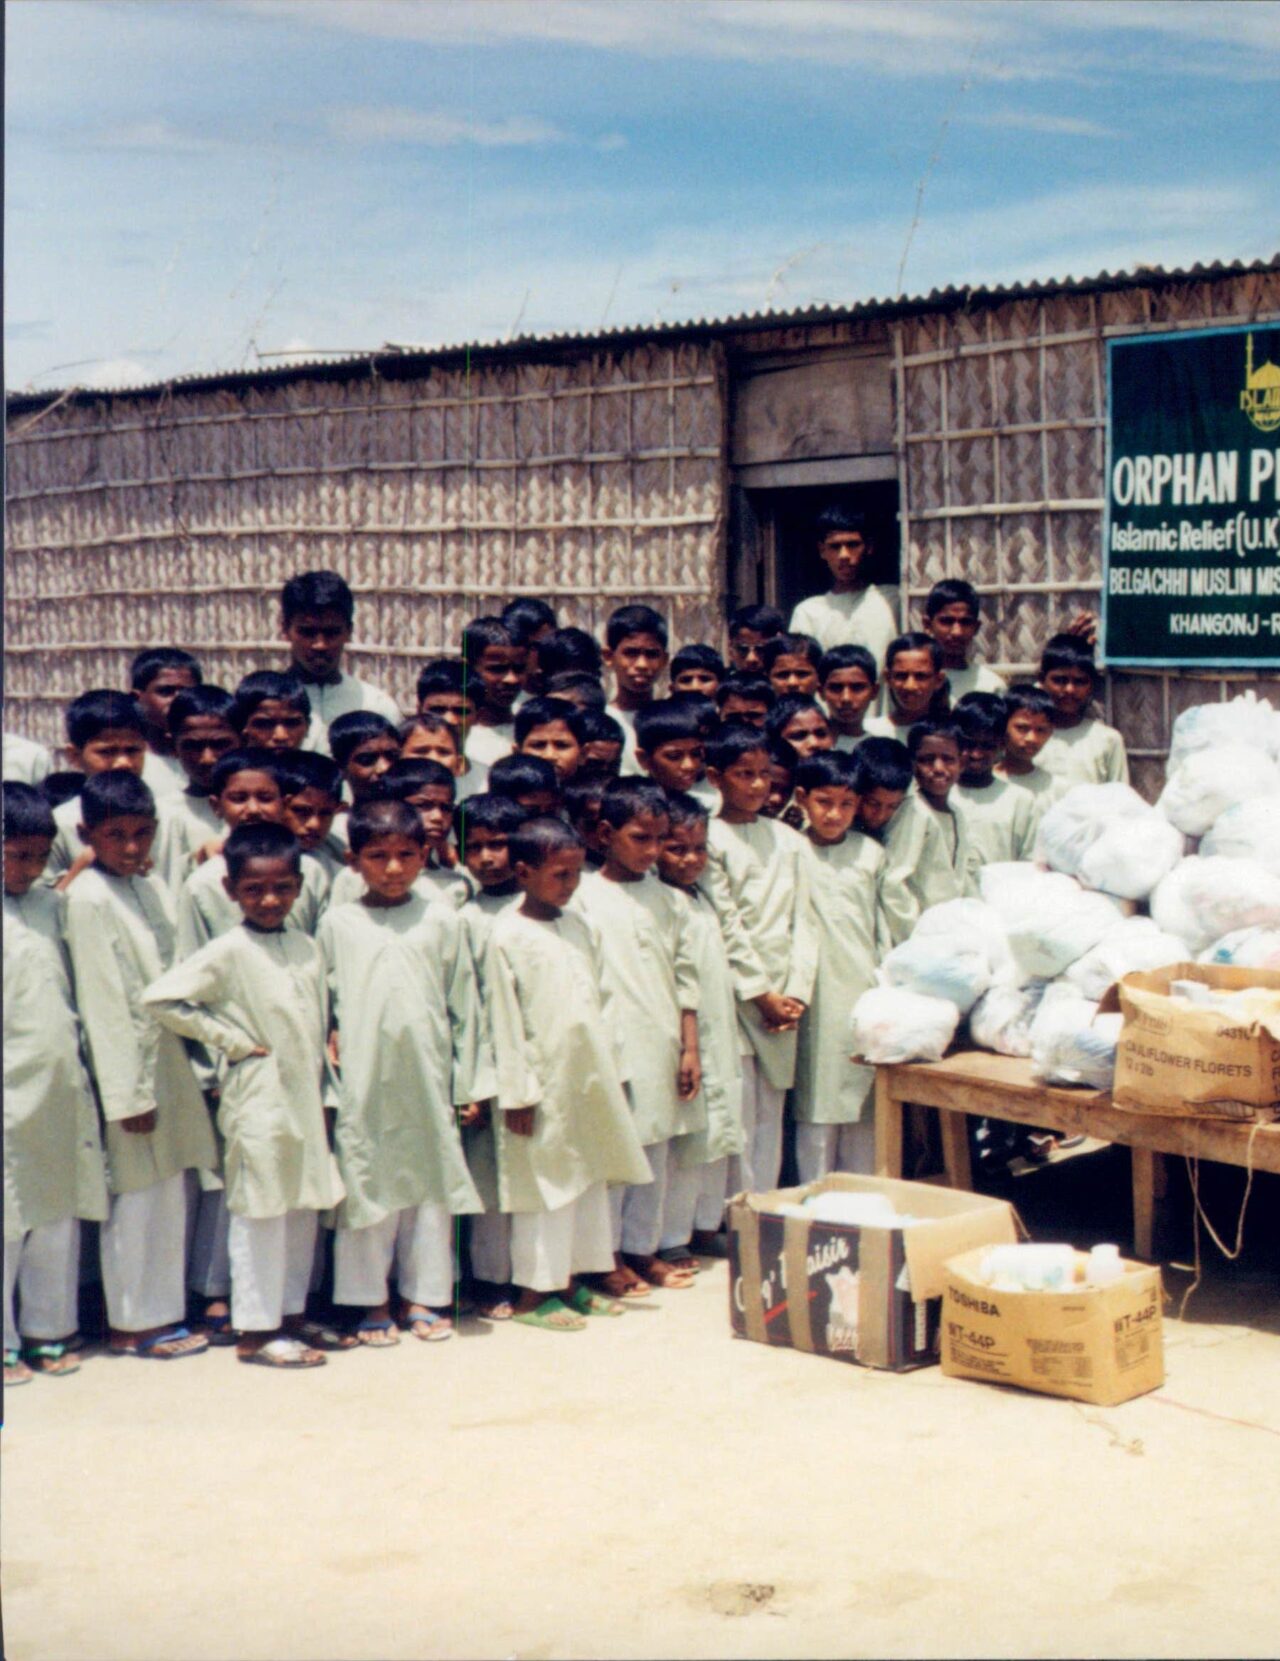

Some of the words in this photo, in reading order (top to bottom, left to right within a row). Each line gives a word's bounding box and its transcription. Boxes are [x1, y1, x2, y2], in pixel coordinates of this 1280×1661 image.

[1112, 451, 1238, 506] ORPHAN
[1111, 521, 1178, 551] Islamic
[1109, 567, 1188, 595] BELGACHHI
[1190, 567, 1253, 596] MUSLIM
[1126, 1039, 1191, 1070] CAULIFLOWER
[1193, 1058, 1253, 1078] FLORETS
[948, 1284, 1001, 1318] TOSHIBA
